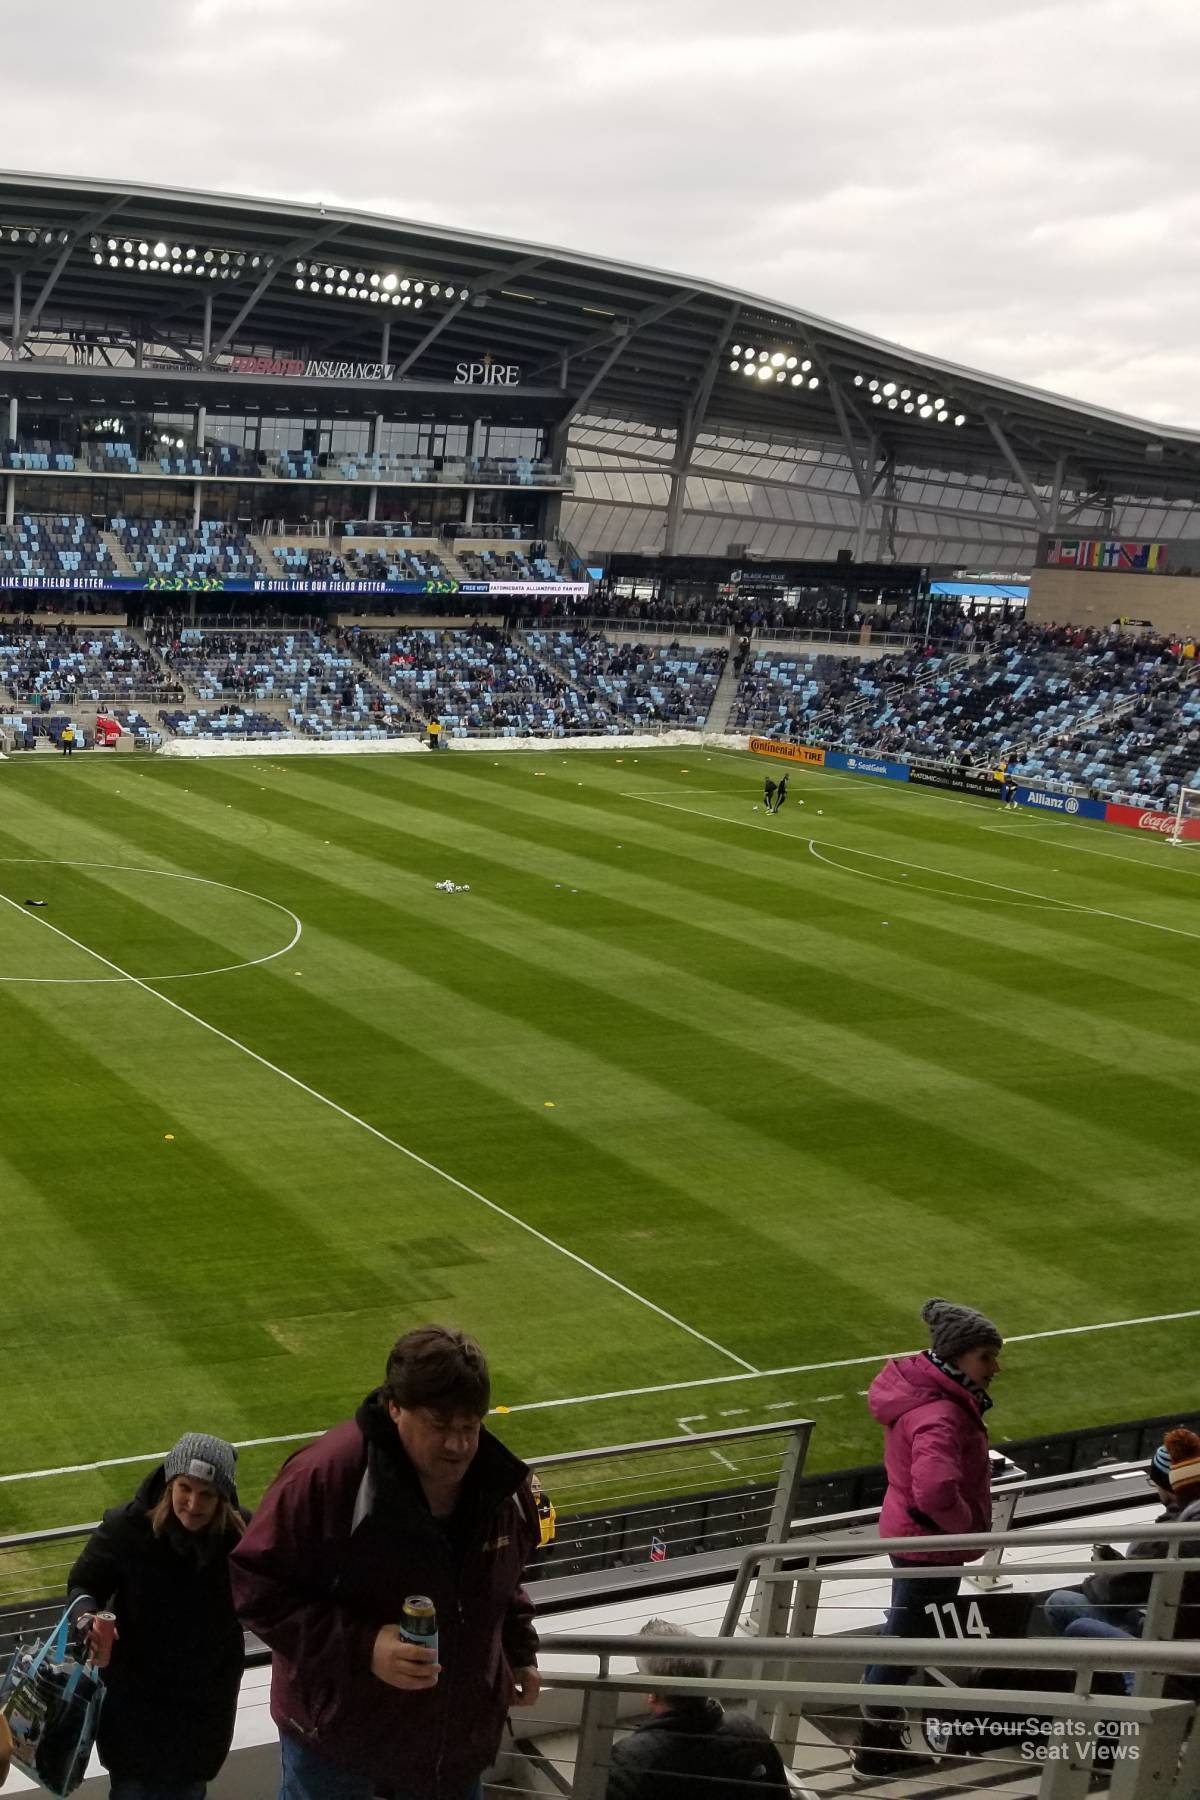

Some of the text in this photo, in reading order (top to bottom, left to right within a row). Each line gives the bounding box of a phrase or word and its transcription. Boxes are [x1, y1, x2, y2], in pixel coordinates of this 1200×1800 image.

[231, 356, 384, 380] FEDERATED INSURANCE
[455, 362, 520, 385] SPIRE
[1, 576, 19, 587] LIKE
[22, 577, 39, 587] OUR
[42, 577, 70, 588] FIELDS
[254, 580, 265, 591] WE
[268, 580, 289, 591] STILL
[292, 581, 308, 591] LIKE
[311, 581, 326, 591] OUR
[329, 581, 355, 591] FIELDS
[751, 737, 823, 762] Continental TIRE
[857, 761, 888, 774] SeatGeek
[1027, 791, 1064, 809] Allianz
[924, 1601, 991, 1639] 114
